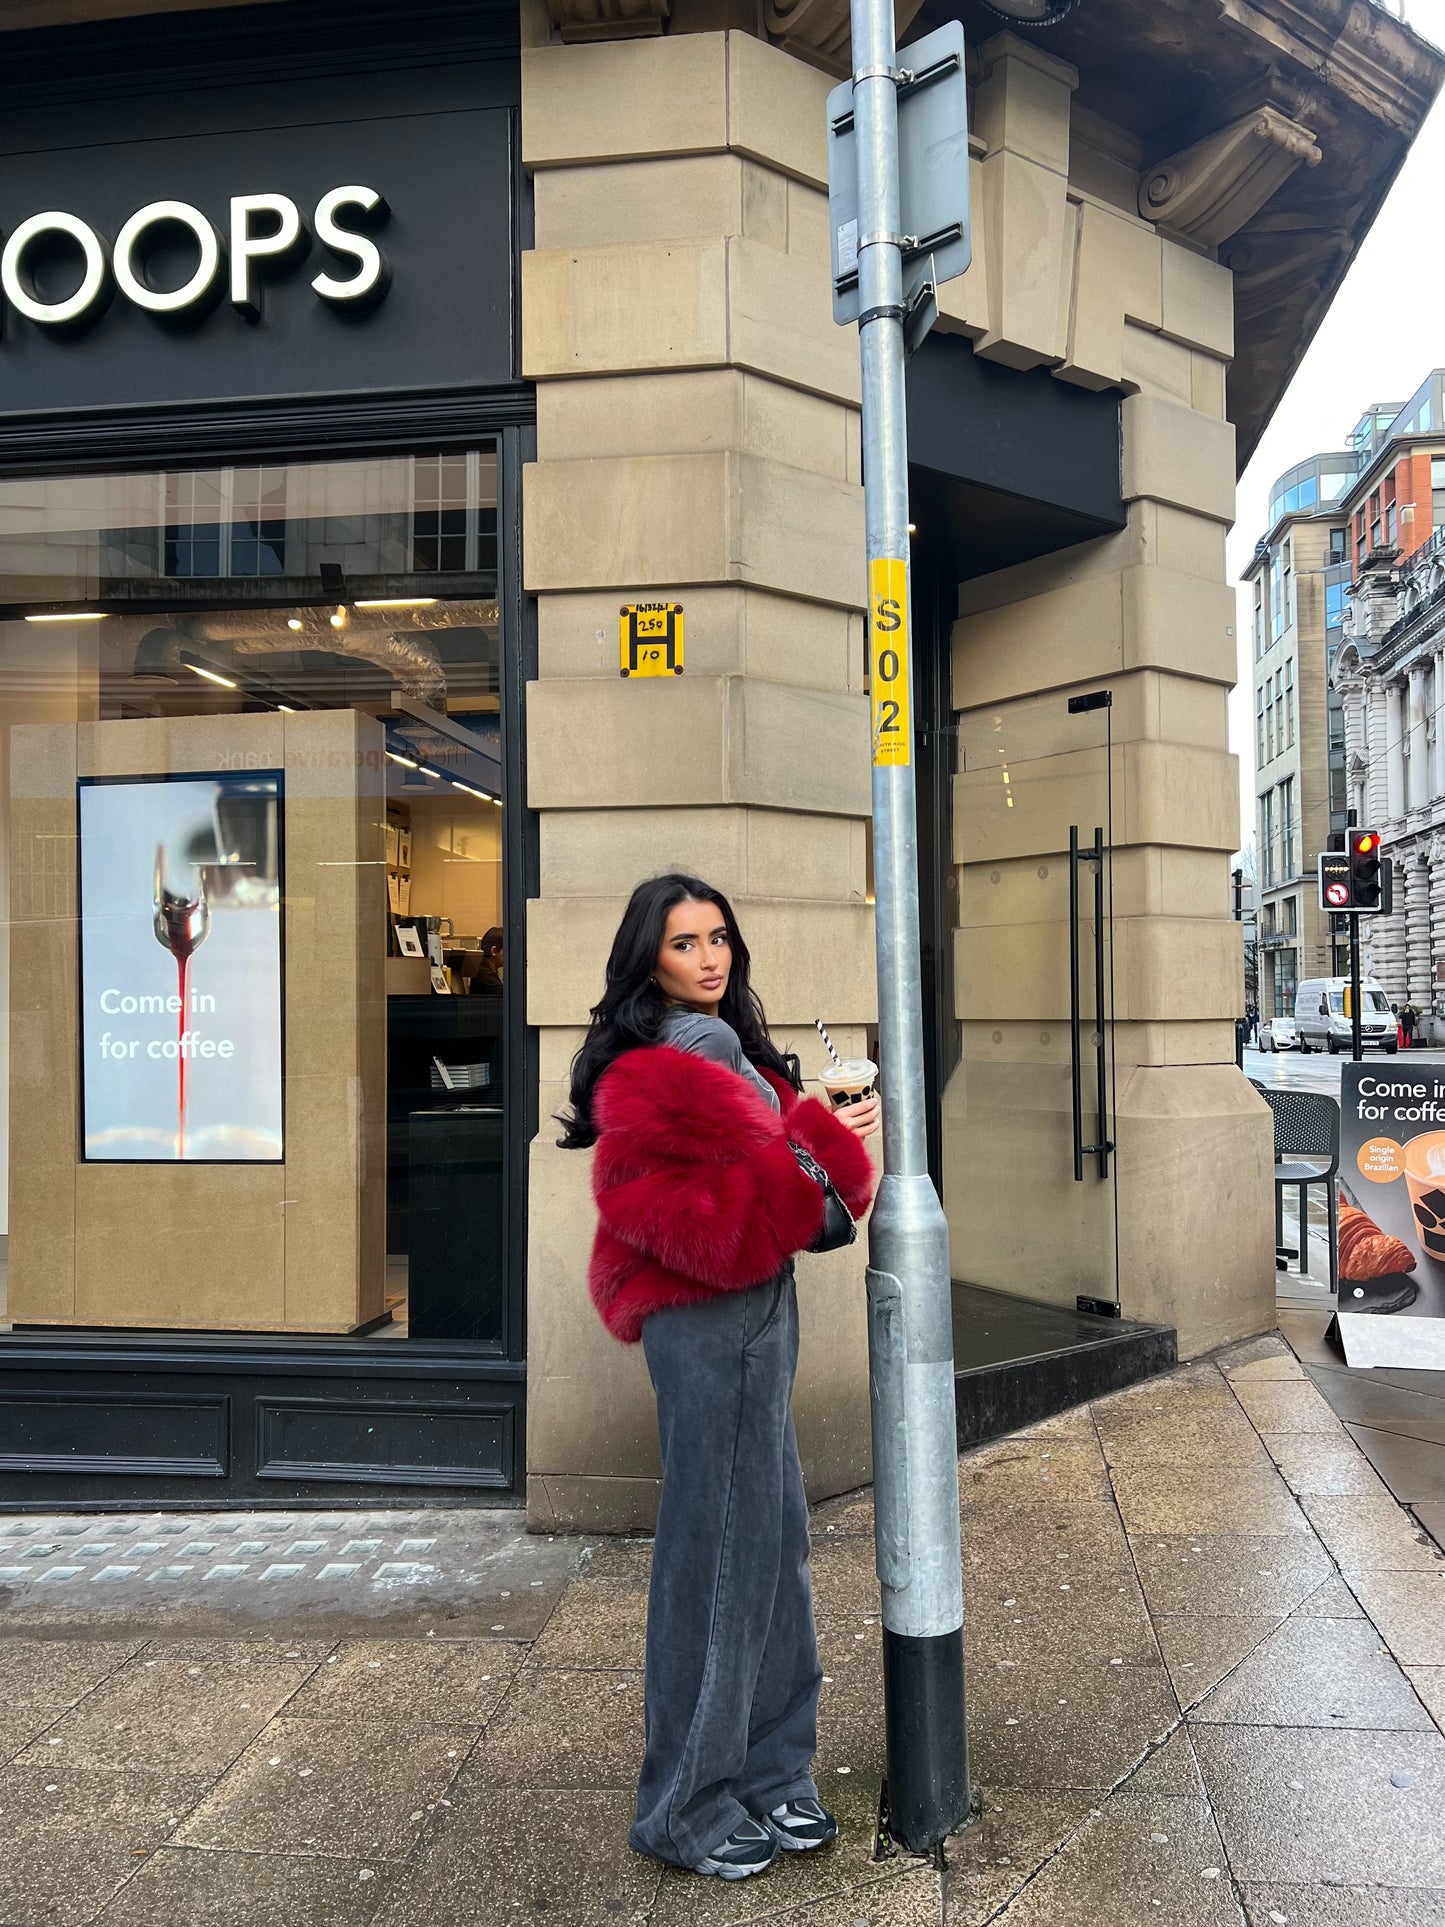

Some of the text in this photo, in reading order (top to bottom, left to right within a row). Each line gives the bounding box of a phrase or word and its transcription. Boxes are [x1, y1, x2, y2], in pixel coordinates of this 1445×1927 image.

[0, 184, 388, 324] OOPS
[638, 619, 663, 632] 250
[630, 611, 675, 670] H
[642, 650, 660, 661] 10
[100, 987, 216, 1015] Come in
[99, 1031, 235, 1059] for coffee
[1357, 1077, 1427, 1098] Come
[1356, 1099, 1389, 1120] for
[1369, 1145, 1395, 1155] Single
[1369, 1154, 1394, 1164] origin
[1364, 1163, 1399, 1172] Brazilian
